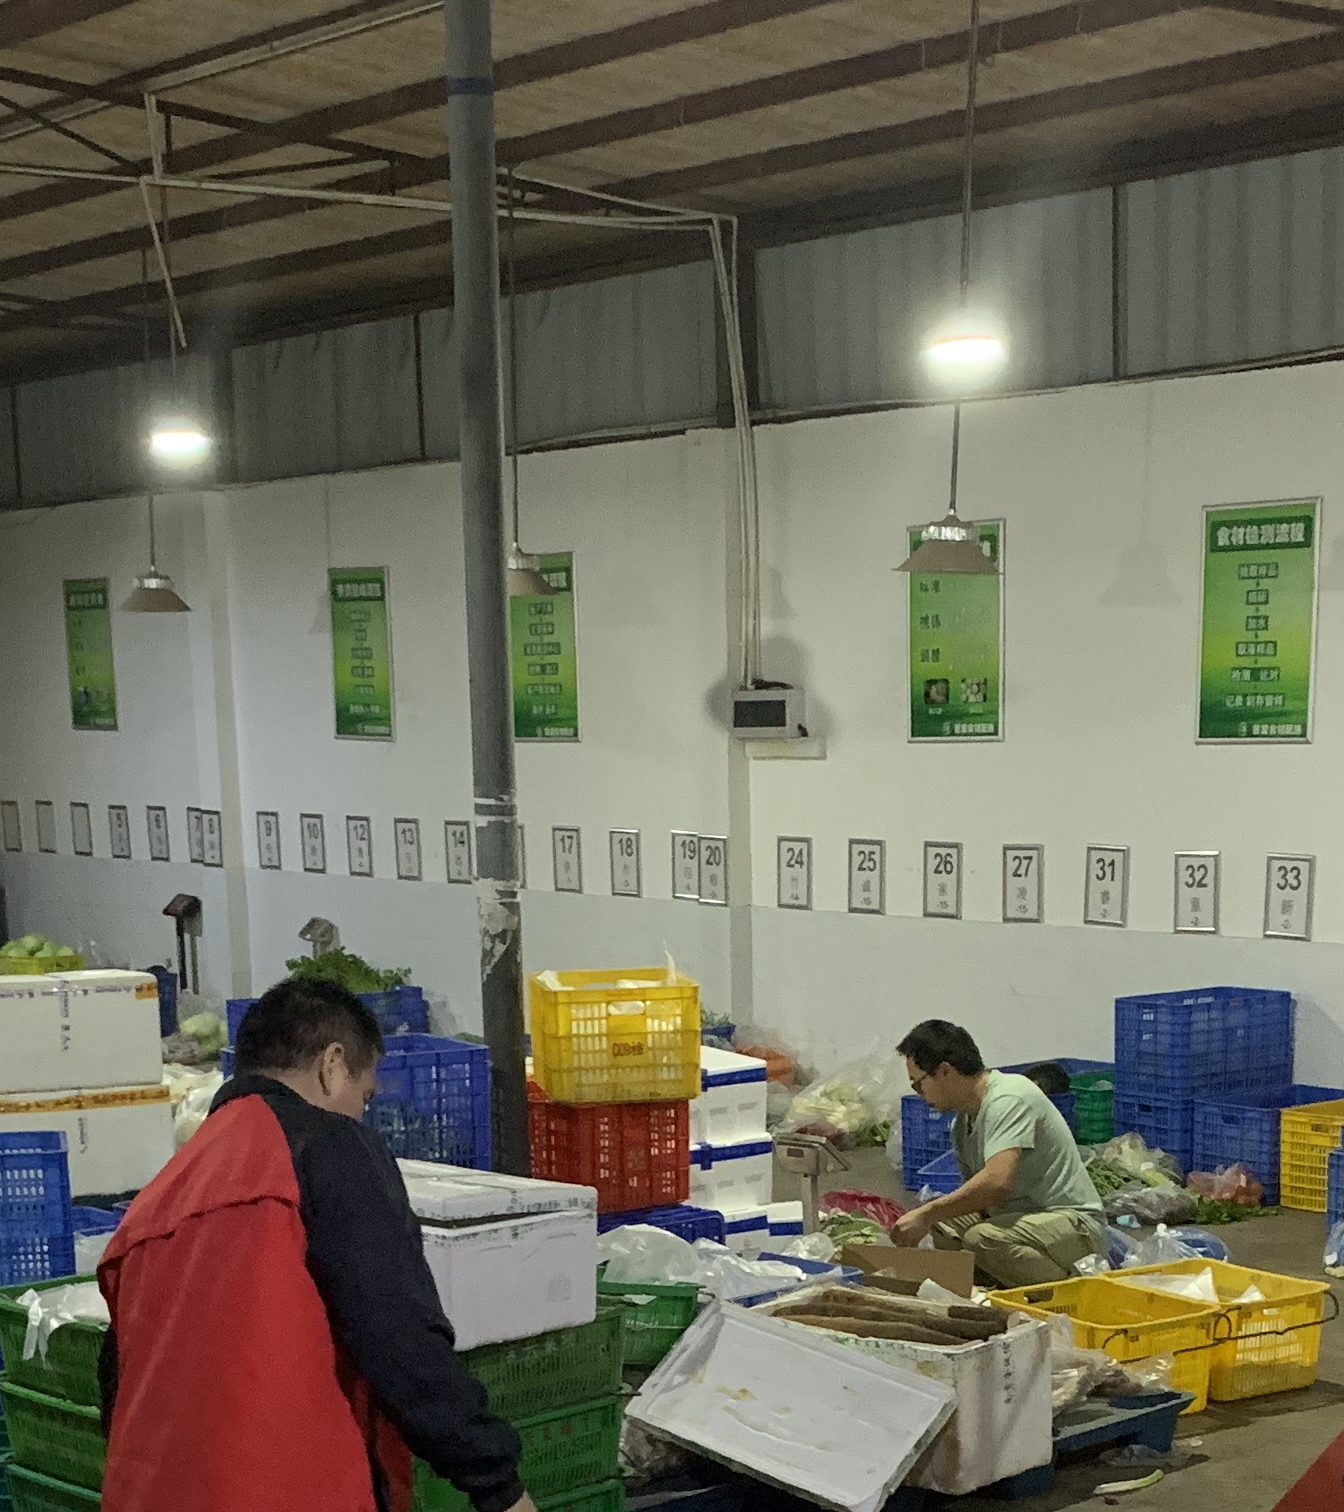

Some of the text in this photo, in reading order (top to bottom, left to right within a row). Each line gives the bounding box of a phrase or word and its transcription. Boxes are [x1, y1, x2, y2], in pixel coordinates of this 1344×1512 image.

[306, 822, 320, 840] 10
[353, 823, 367, 842] 12
[400, 827, 416, 846] 13
[559, 834, 575, 855] 17
[618, 837, 634, 858] 18
[680, 840, 697, 860] 19
[704, 845, 722, 866] 20
[785, 847, 805, 869] 24
[856, 850, 877, 873] 25
[933, 852, 954, 875] 26
[1011, 855, 1034, 878] 27
[1094, 857, 1117, 882] 31
[1184, 863, 1209, 889] 32
[1275, 865, 1302, 891] 33
